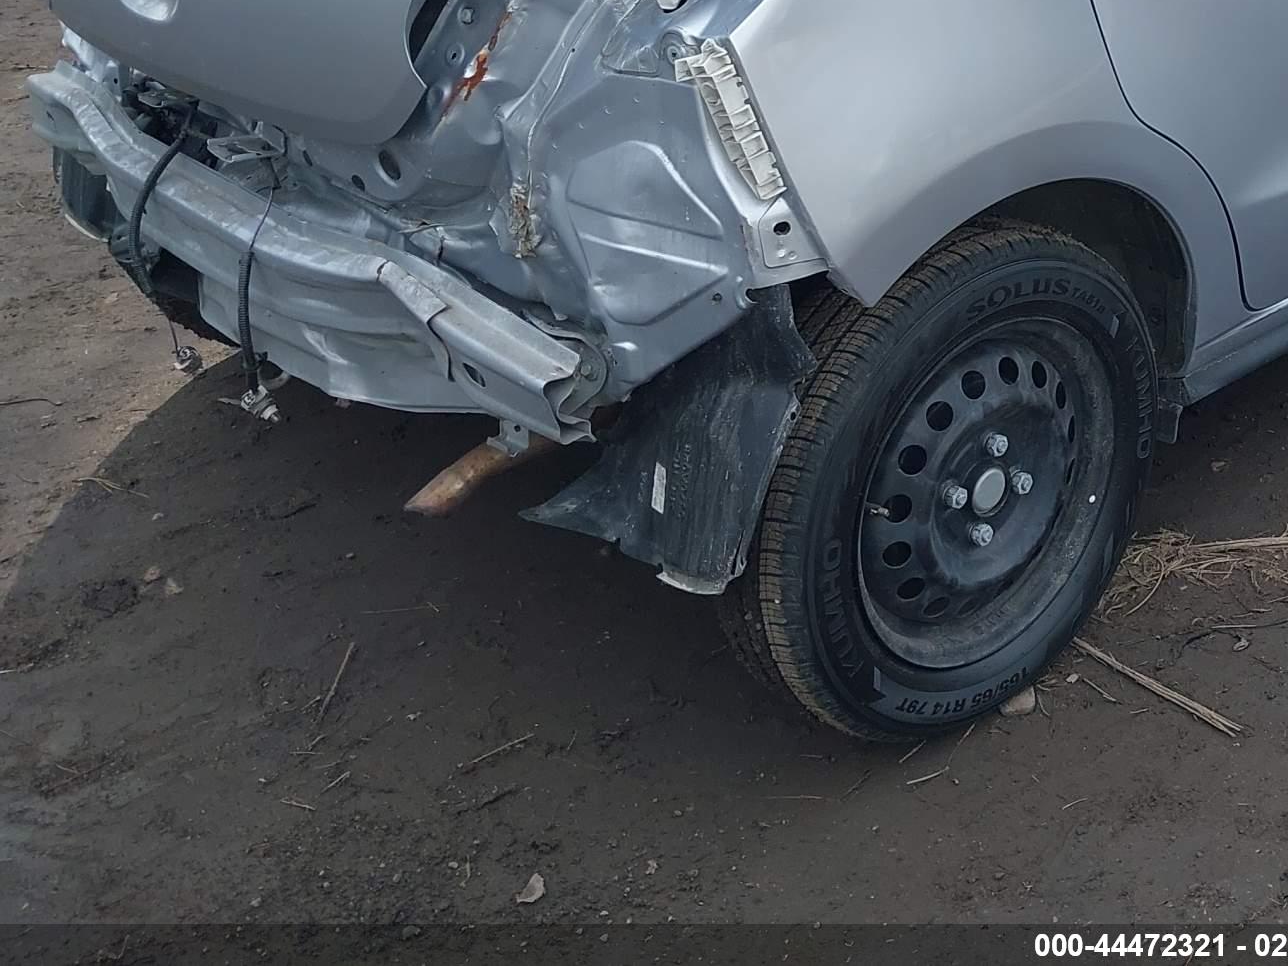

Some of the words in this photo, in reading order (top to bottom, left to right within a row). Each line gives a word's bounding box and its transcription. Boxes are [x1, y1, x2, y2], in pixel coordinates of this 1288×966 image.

[965, 277, 1072, 321] SOLUS
[1125, 335, 1154, 460] KUMHO
[823, 537, 865, 679] KUMHO
[894, 696, 929, 716] 79T
[930, 697, 968, 717] R14
[970, 666, 1030, 709] 165/65
